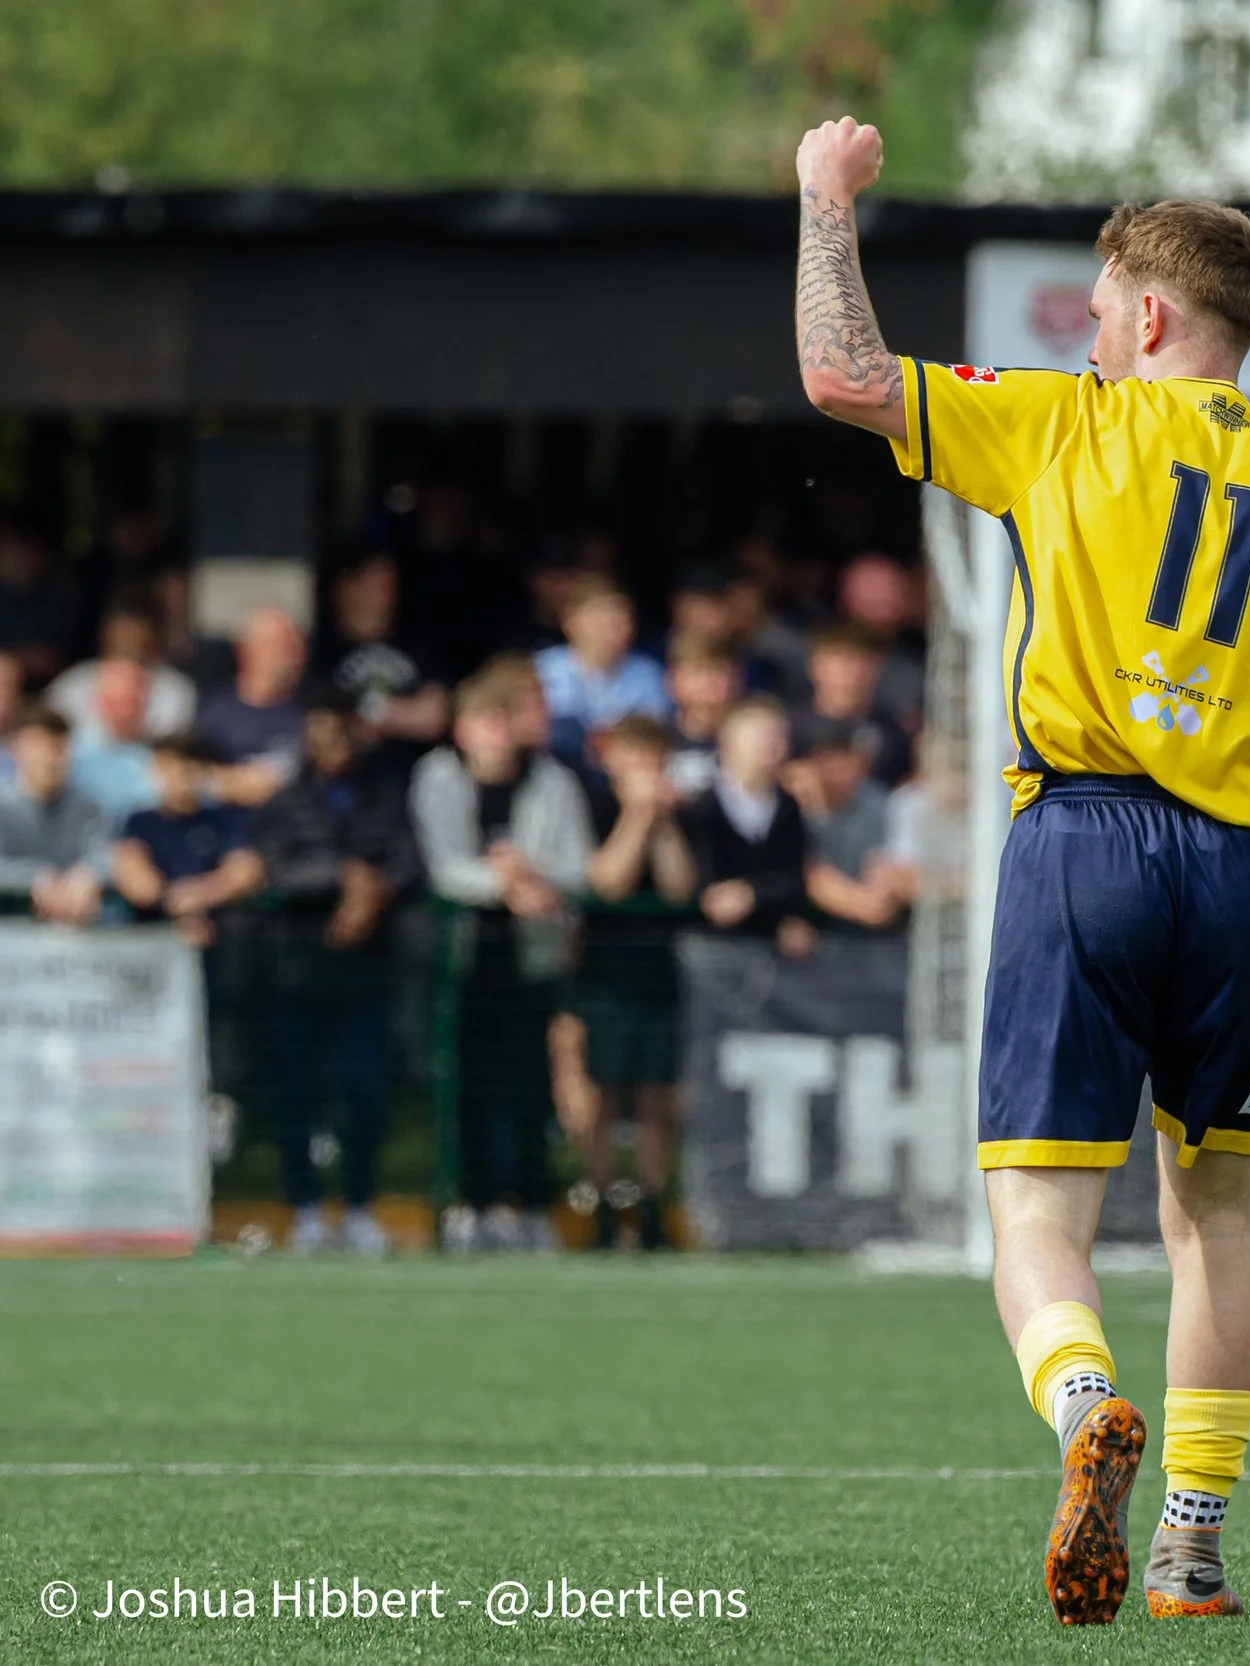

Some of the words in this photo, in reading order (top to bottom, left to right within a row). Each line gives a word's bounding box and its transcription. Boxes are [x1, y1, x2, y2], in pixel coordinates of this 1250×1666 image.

[1114, 668, 1143, 684] CKR
[1146, 676, 1205, 703] UTILITIES
[1208, 695, 1233, 711] LTD
[718, 1030, 966, 1198] TH
